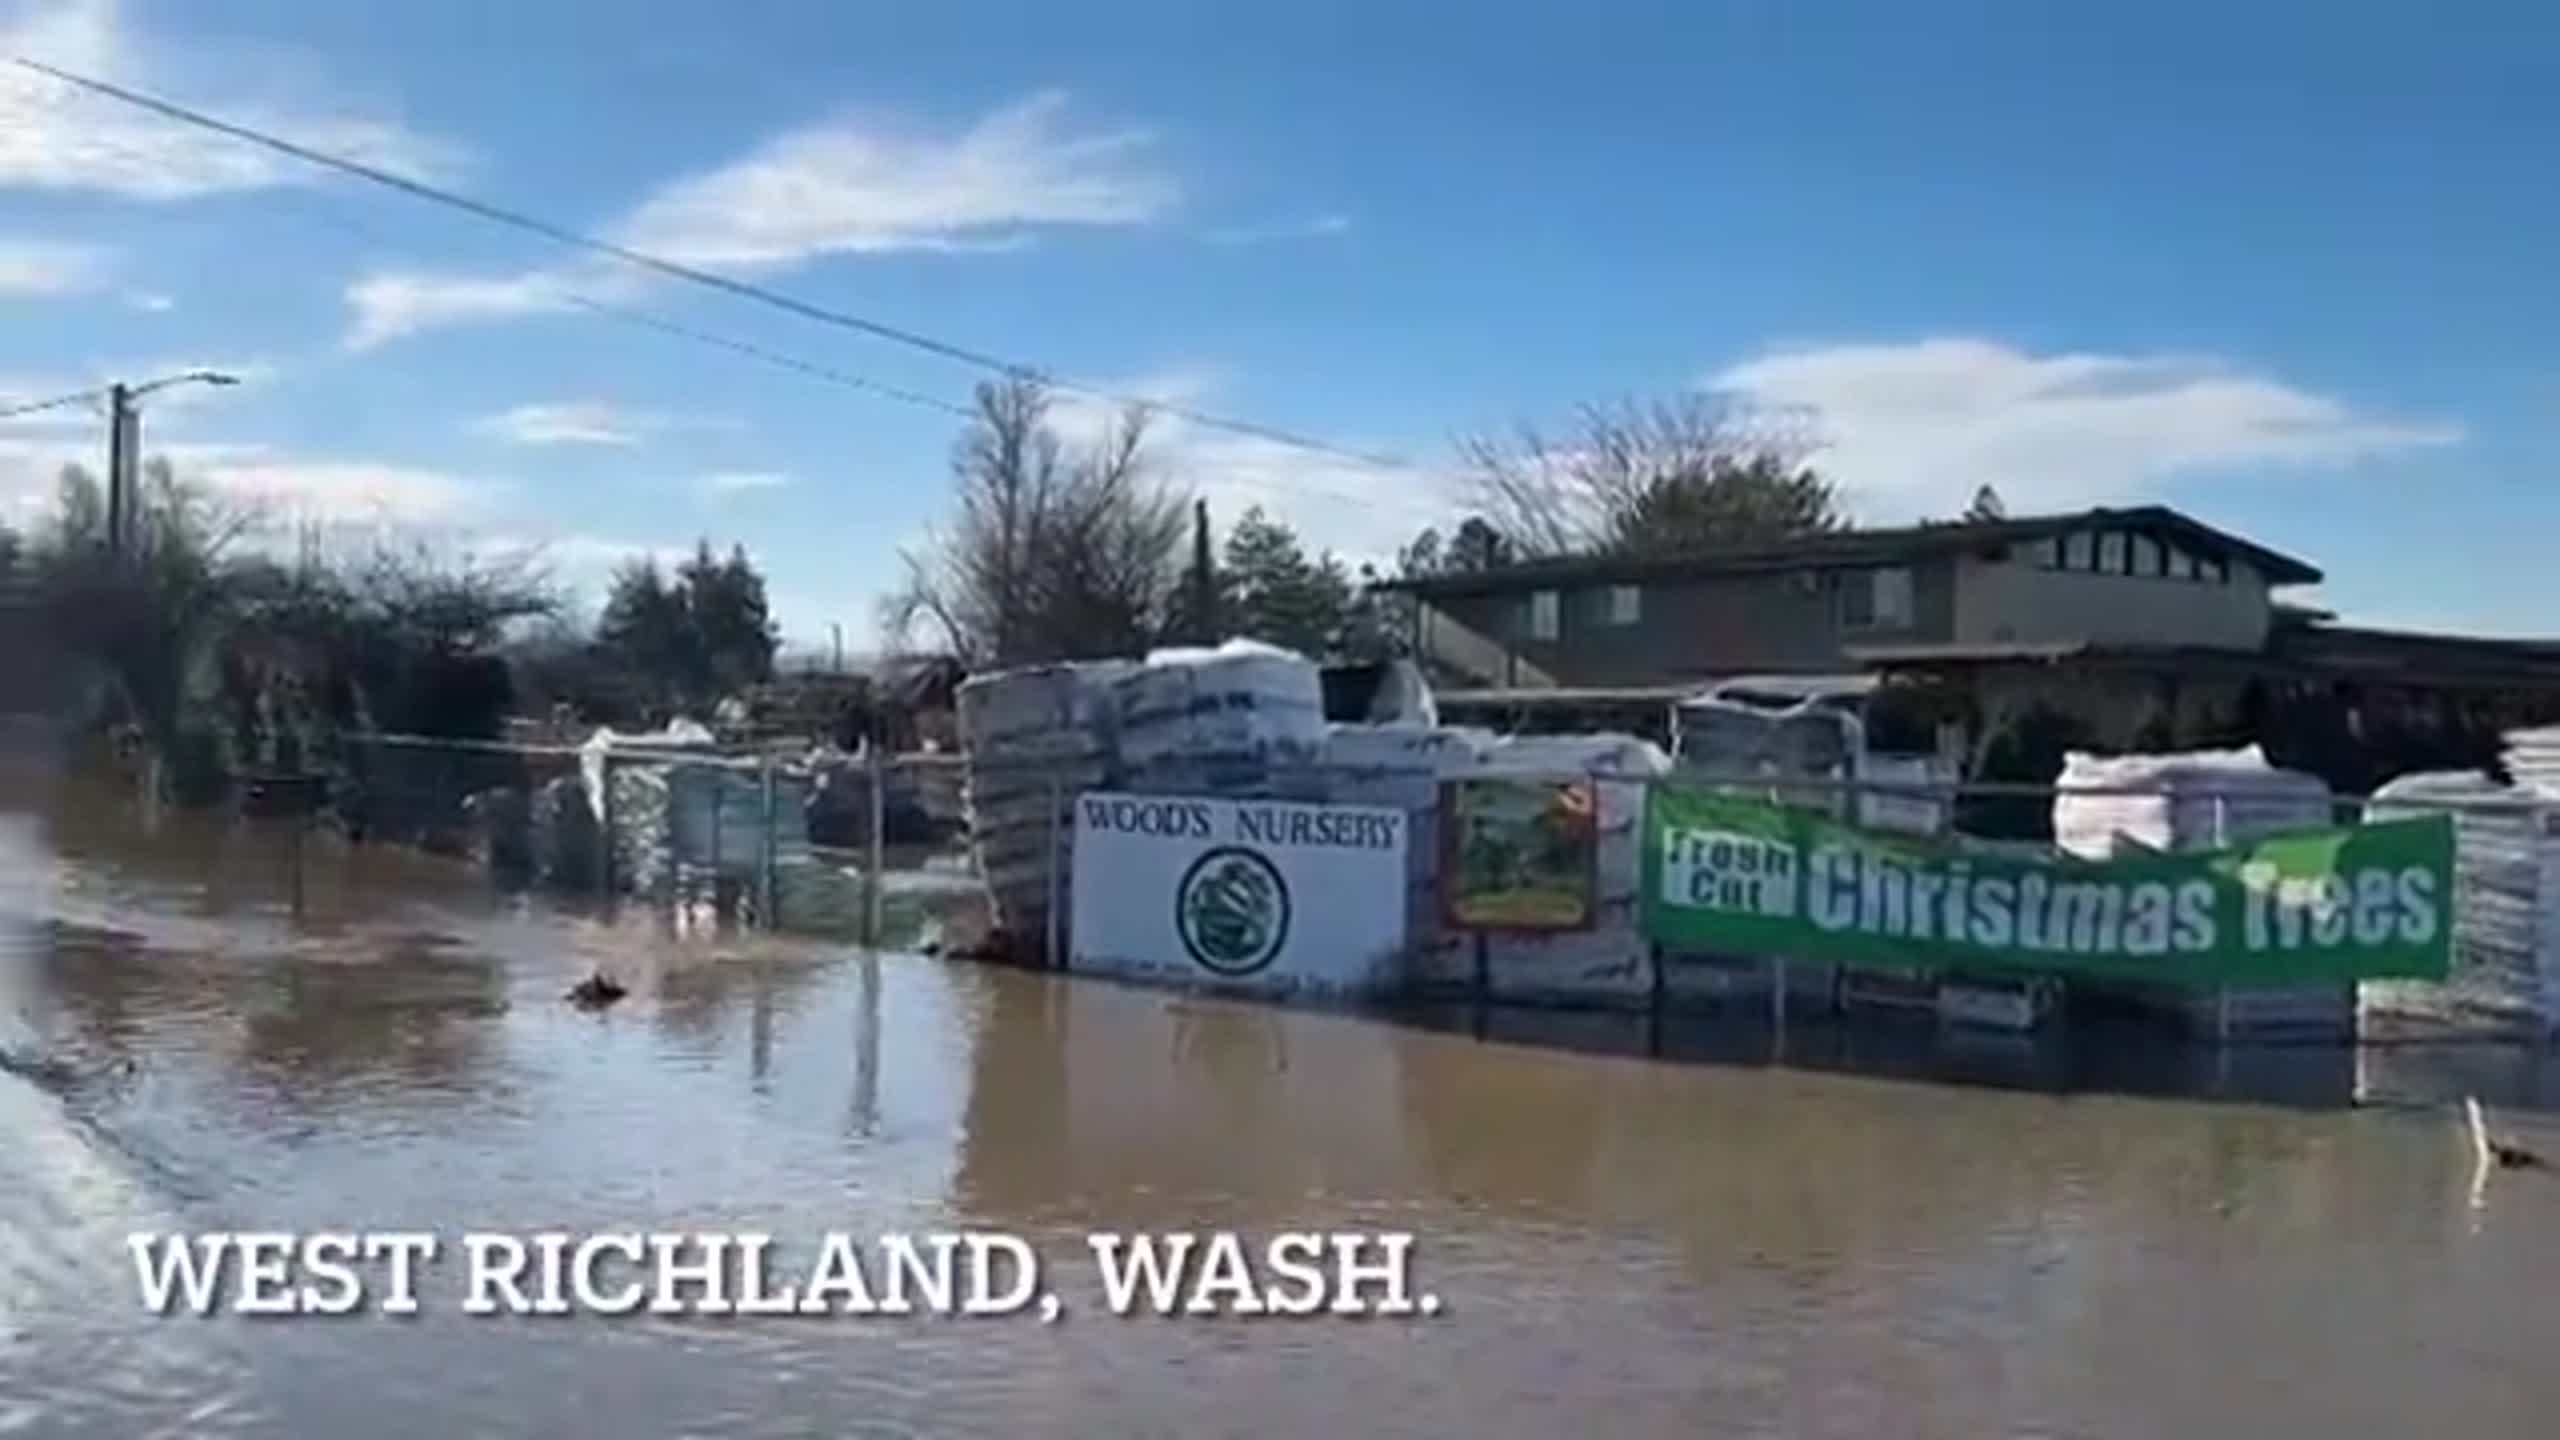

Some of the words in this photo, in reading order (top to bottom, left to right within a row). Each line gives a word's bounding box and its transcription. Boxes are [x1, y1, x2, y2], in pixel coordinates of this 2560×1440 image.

[1235, 807, 1399, 849] NURSERY
[1690, 866, 1762, 912] Cut
[1808, 844, 2218, 956] Christmas
[2240, 859, 2438, 950] Trees
